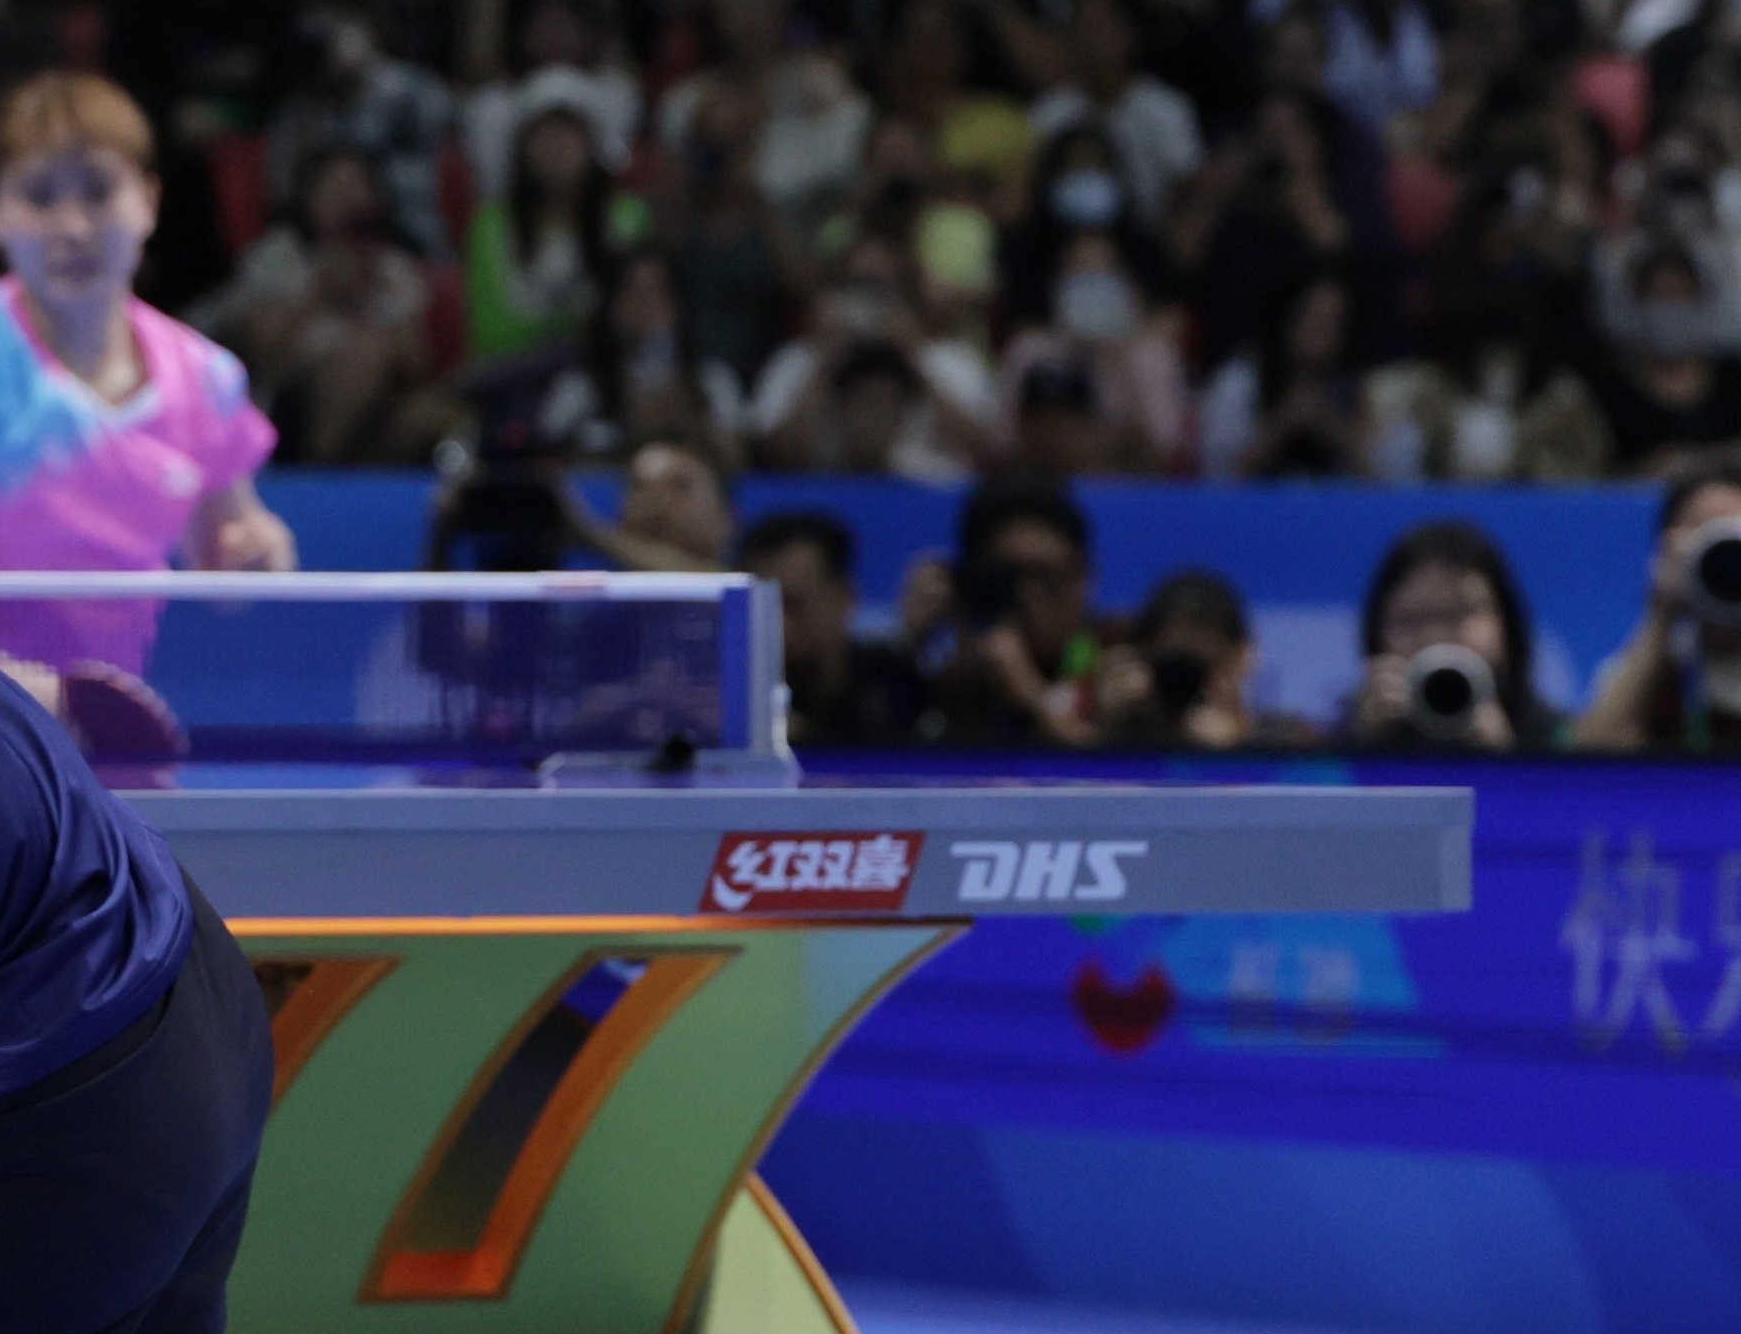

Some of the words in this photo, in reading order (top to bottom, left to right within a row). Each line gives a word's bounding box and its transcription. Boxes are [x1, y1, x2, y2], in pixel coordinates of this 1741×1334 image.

[711, 833, 910, 911] 红双喜
[950, 840, 1150, 902] DHS
